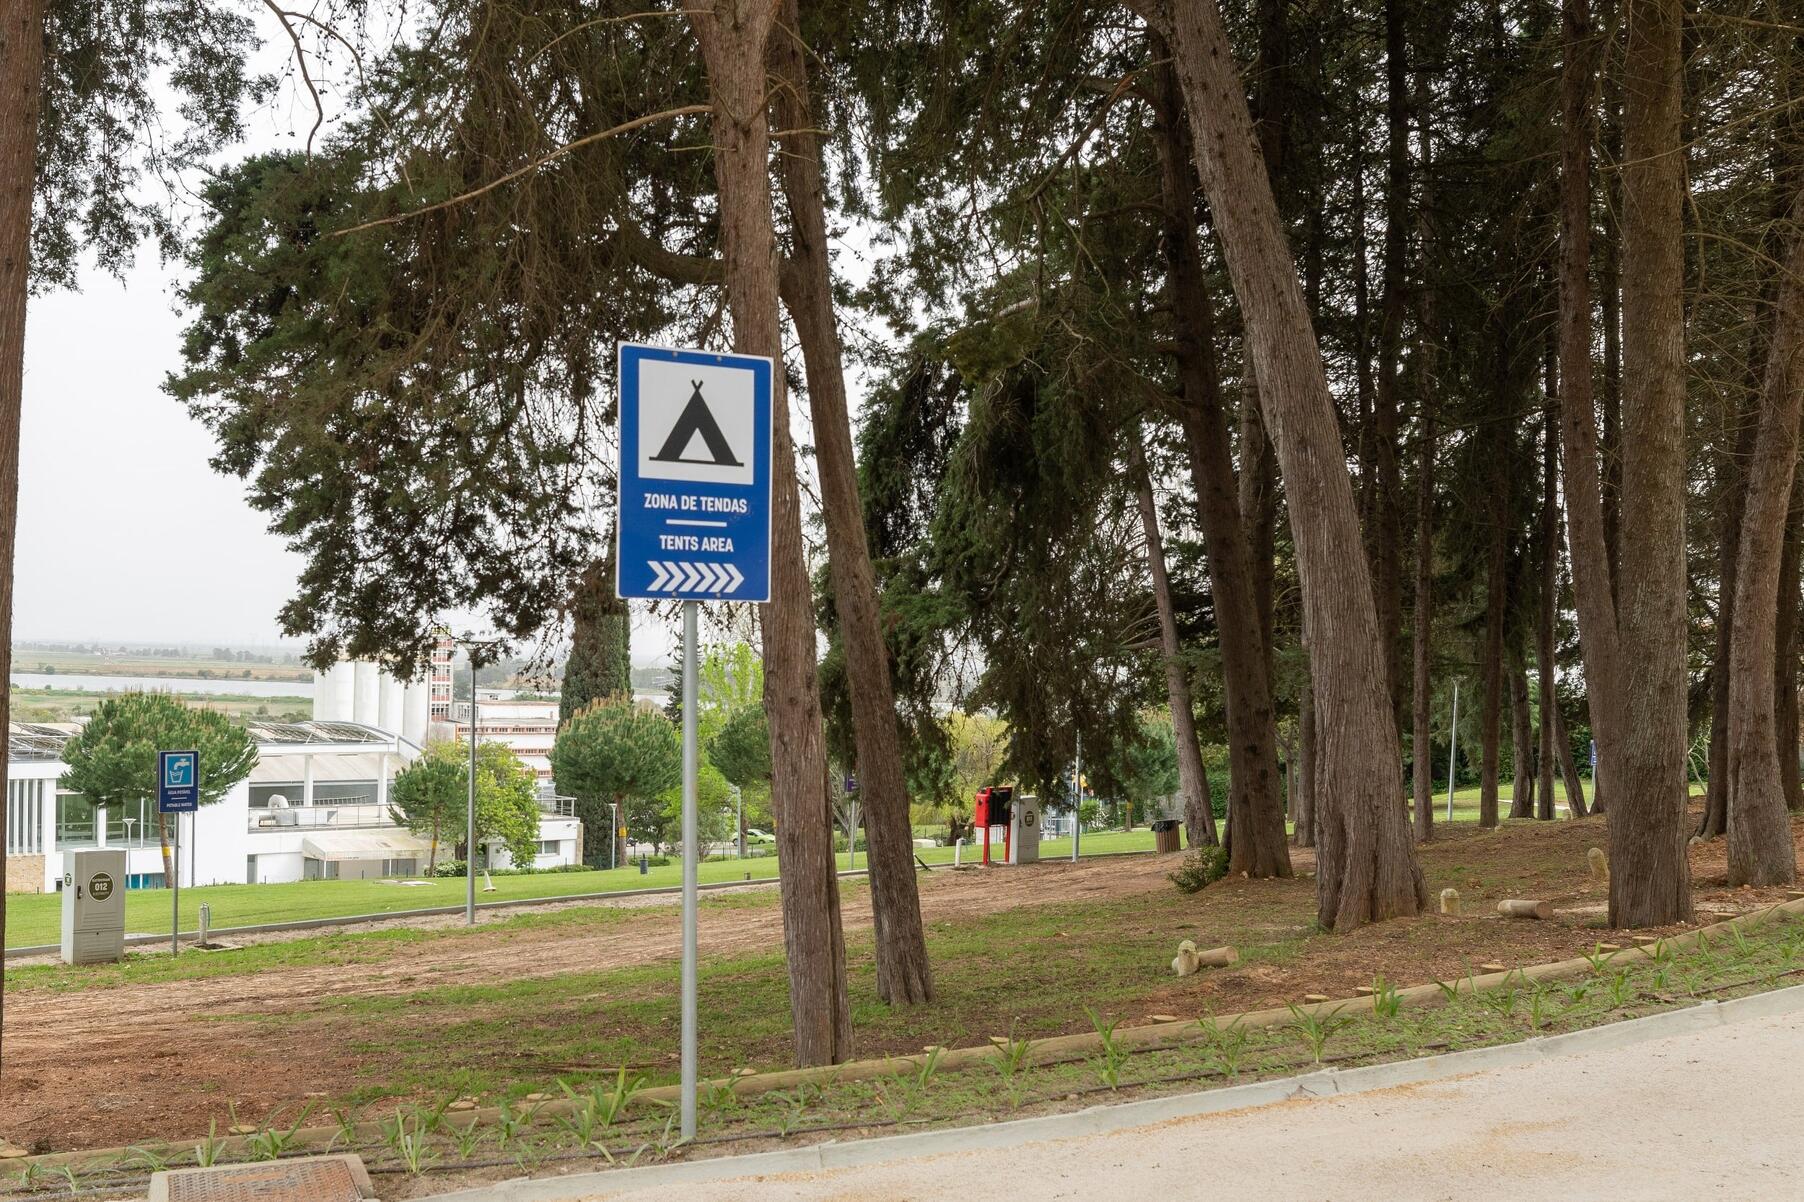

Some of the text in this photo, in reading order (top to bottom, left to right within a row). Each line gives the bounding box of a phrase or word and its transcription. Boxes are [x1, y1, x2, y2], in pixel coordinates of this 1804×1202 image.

[644, 493, 748, 513] ZONA DE TENDAS
[659, 534, 734, 552] TENTS AREA
[94, 882, 108, 891] 012
